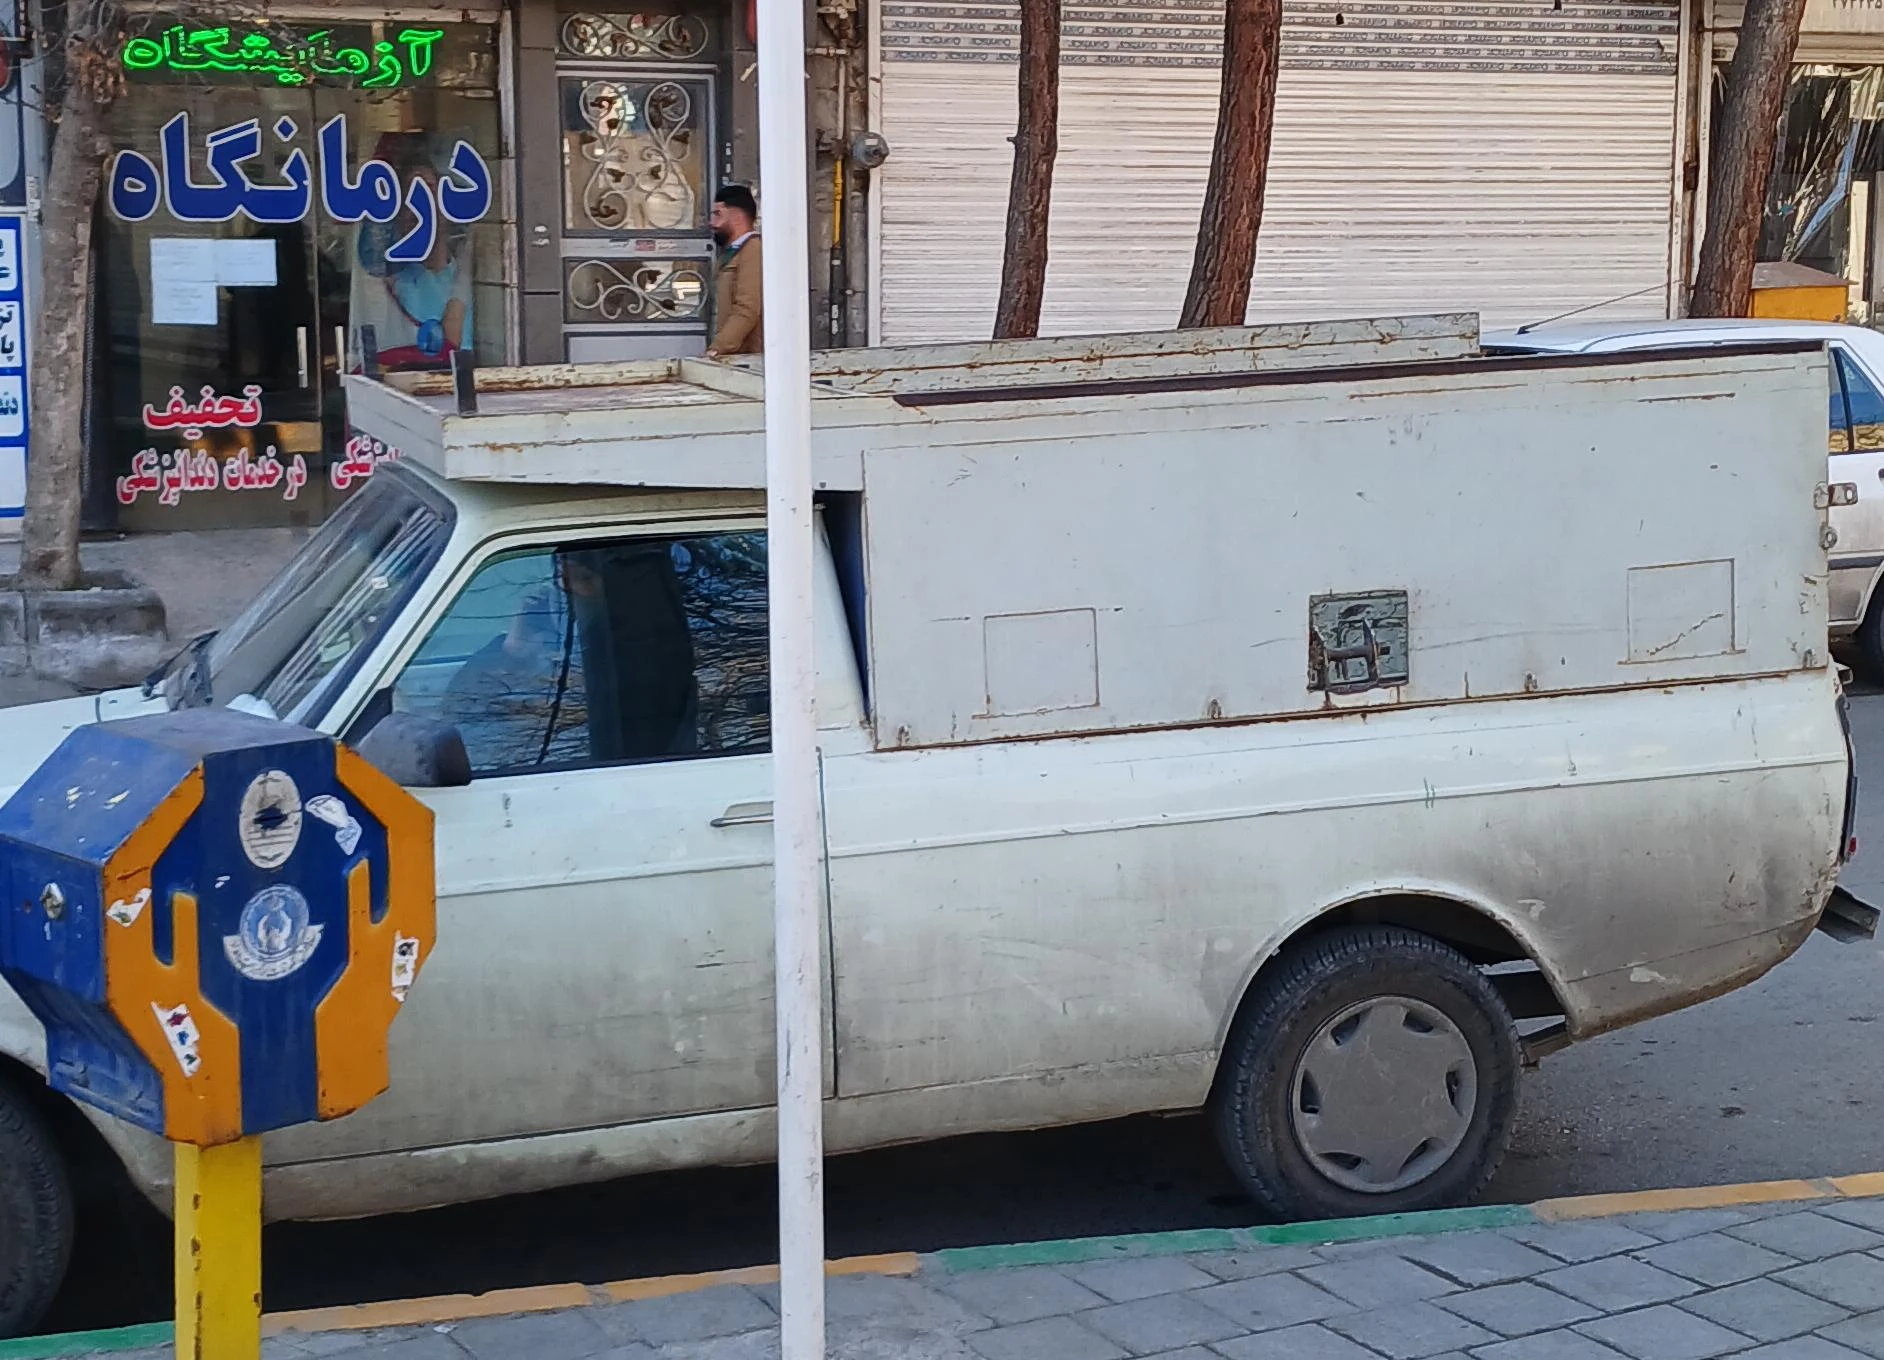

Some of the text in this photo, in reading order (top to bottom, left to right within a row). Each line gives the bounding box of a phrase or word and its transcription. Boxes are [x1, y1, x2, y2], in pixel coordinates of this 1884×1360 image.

[123, 25, 444, 88] آزمایشگاه
[109, 111, 493, 262] درمانگاه
[223, 445, 284, 490] خدمات
[283, 454, 307, 500] در
